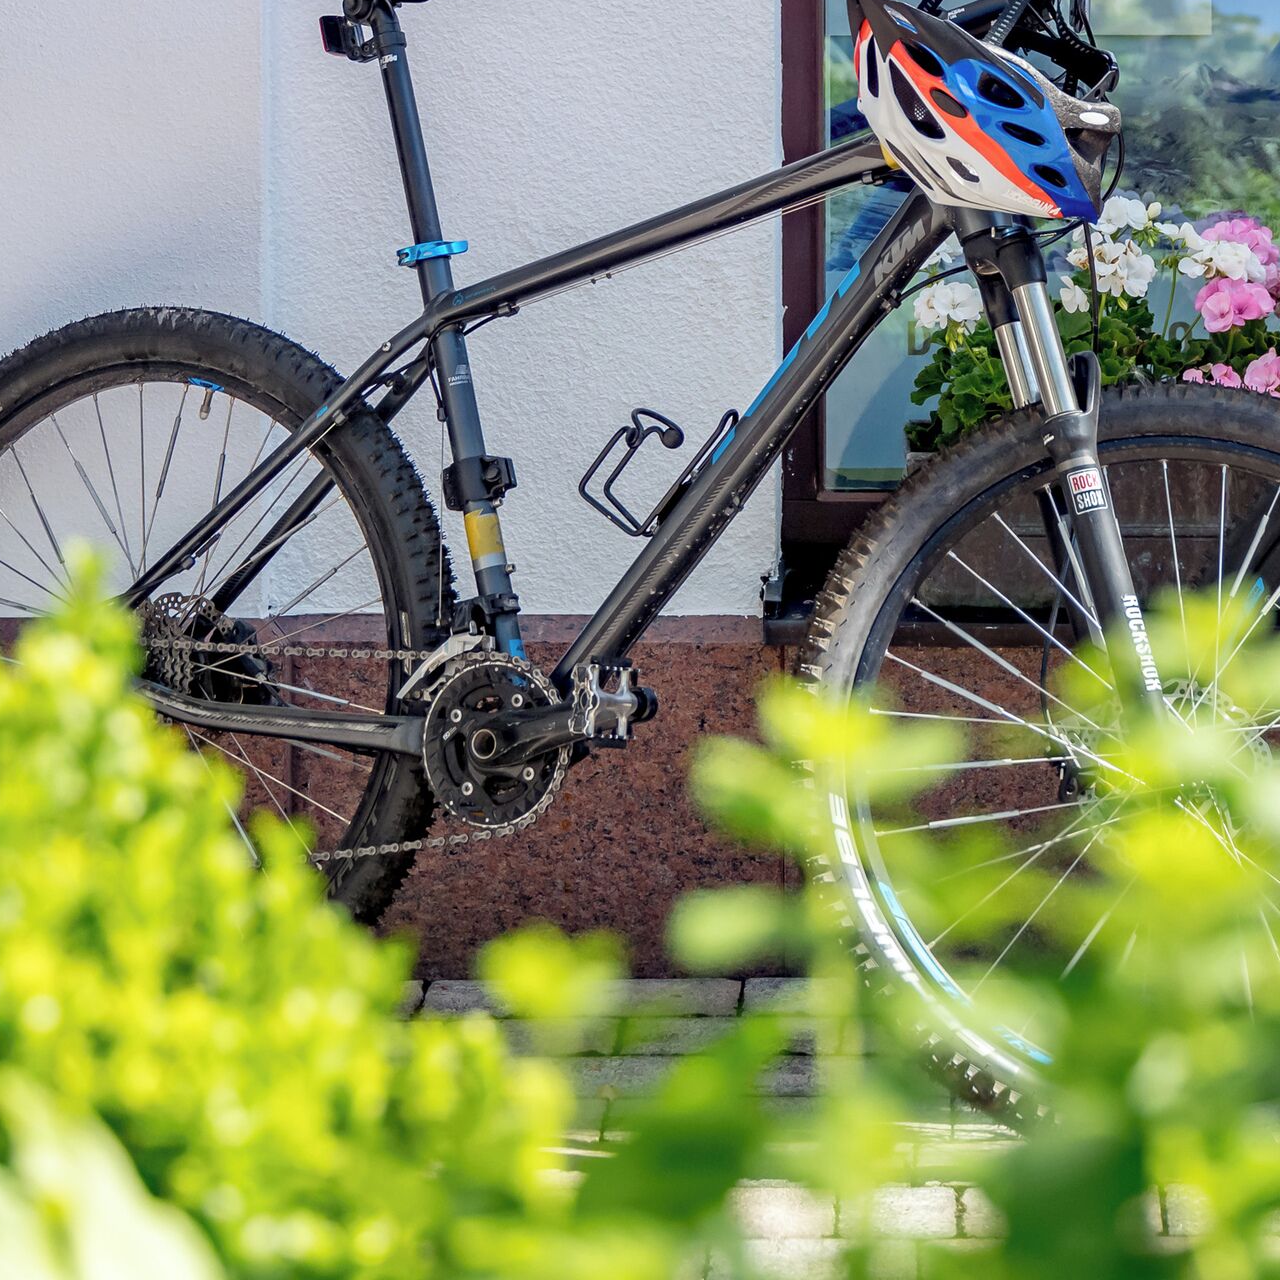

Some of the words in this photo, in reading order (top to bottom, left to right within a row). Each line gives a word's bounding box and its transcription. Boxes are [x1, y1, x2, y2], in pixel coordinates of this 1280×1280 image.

[873, 217, 928, 287] KTM
[1072, 473, 1099, 492] ROCK
[1076, 490, 1105, 510] SHOX
[1120, 593, 1163, 693] ROCKSHOX
